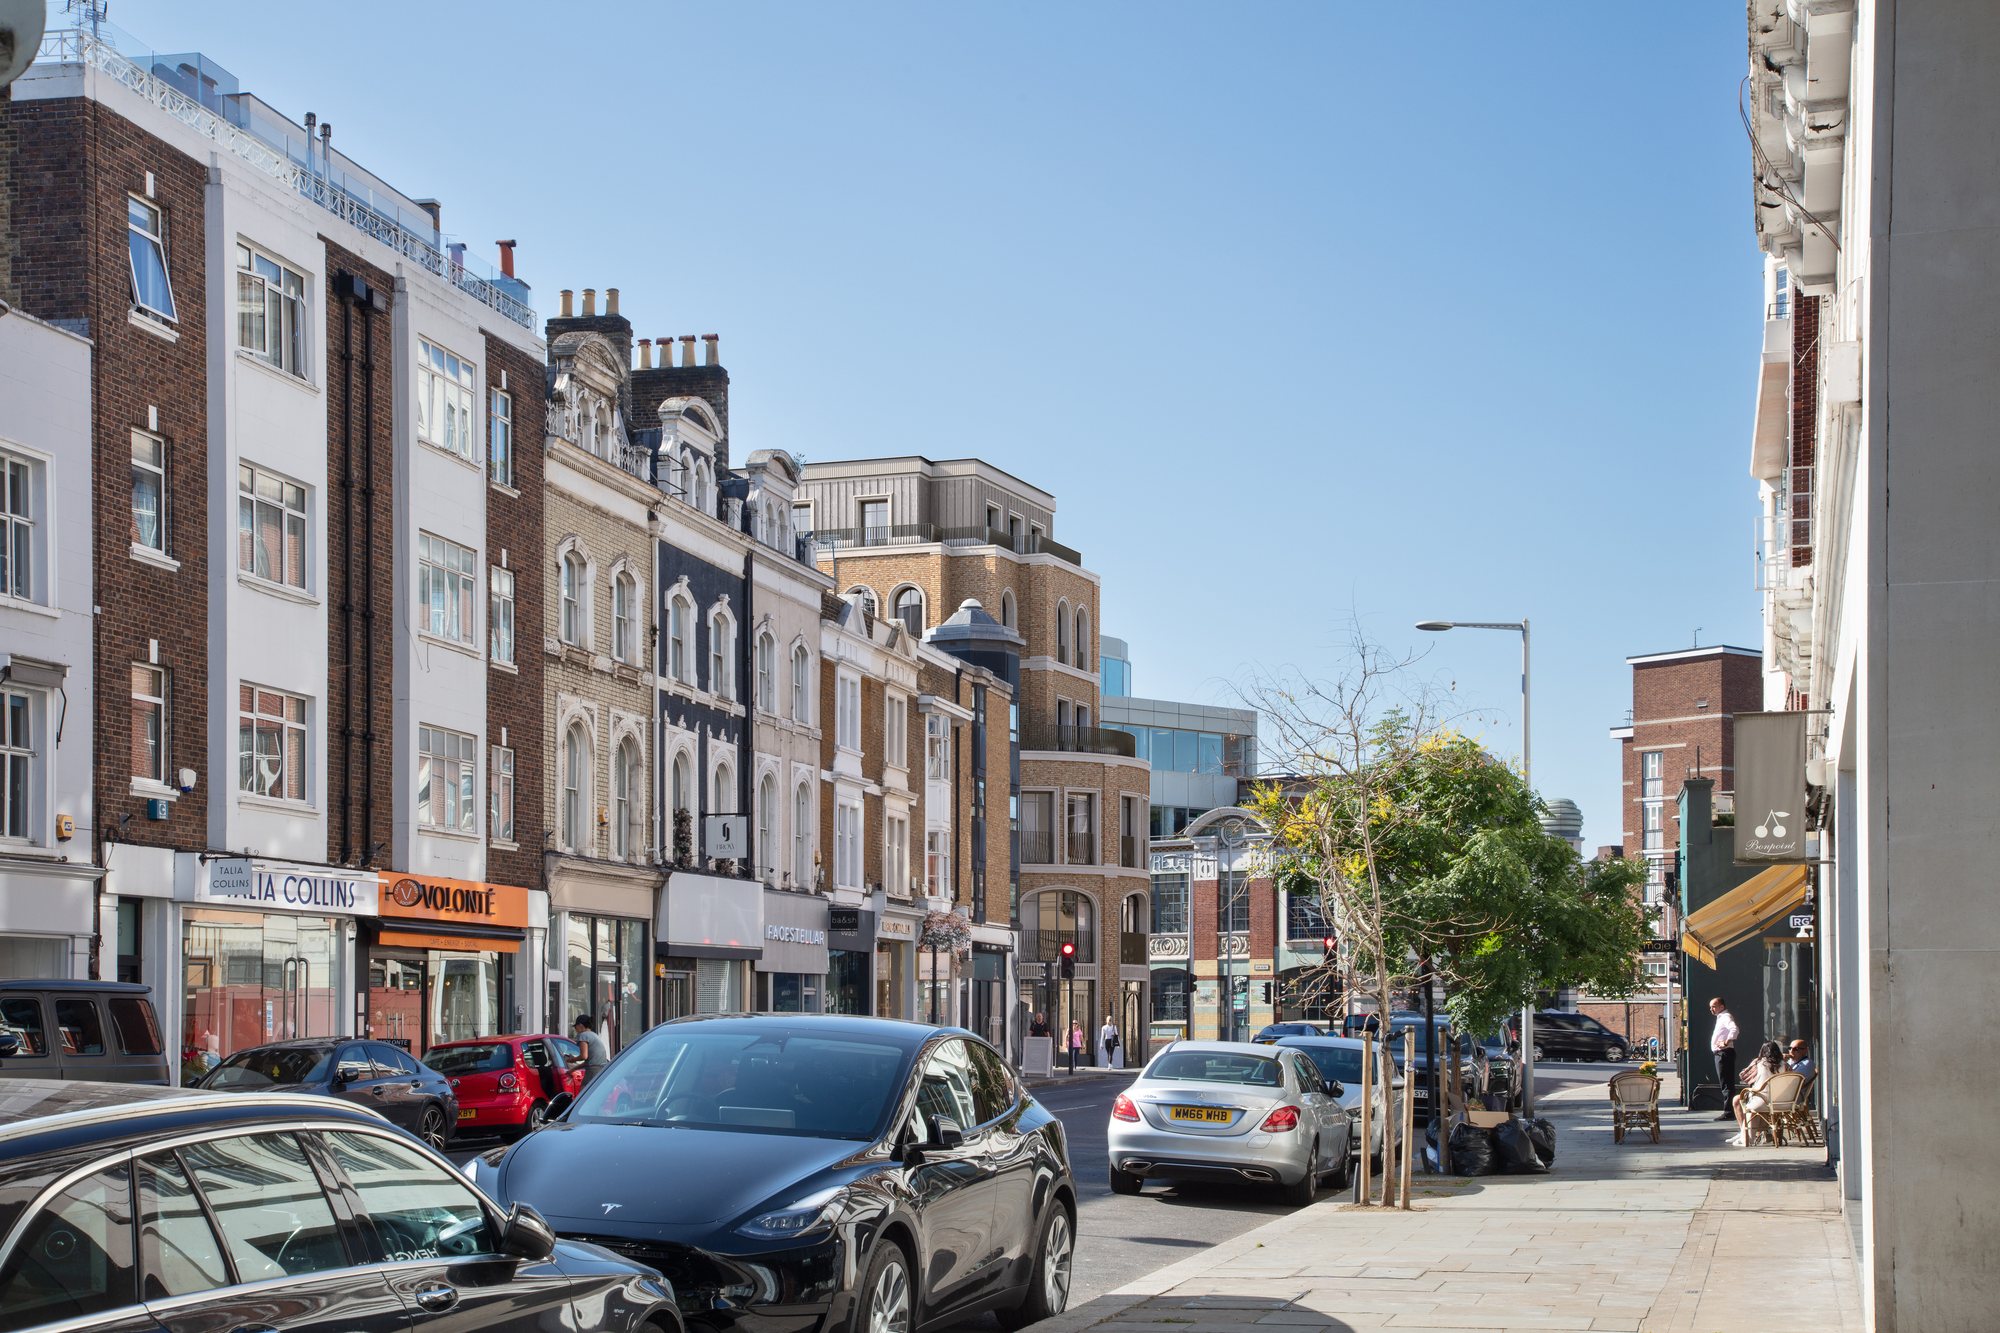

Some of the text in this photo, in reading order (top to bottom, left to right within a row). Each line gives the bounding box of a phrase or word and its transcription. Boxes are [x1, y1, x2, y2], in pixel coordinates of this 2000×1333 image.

[1745, 840, 1796, 854] Bonpoint
[219, 866, 243, 875] TALIA
[212, 879, 249, 888] COLLINS
[284, 875, 355, 908] COLLINS
[421, 884, 496, 916] VOLONTÉ
[831, 916, 857, 924] ba&sh
[768, 925, 825, 945] FACESTELLAR
[1175, 1108, 1228, 1121] WM66 WHB
